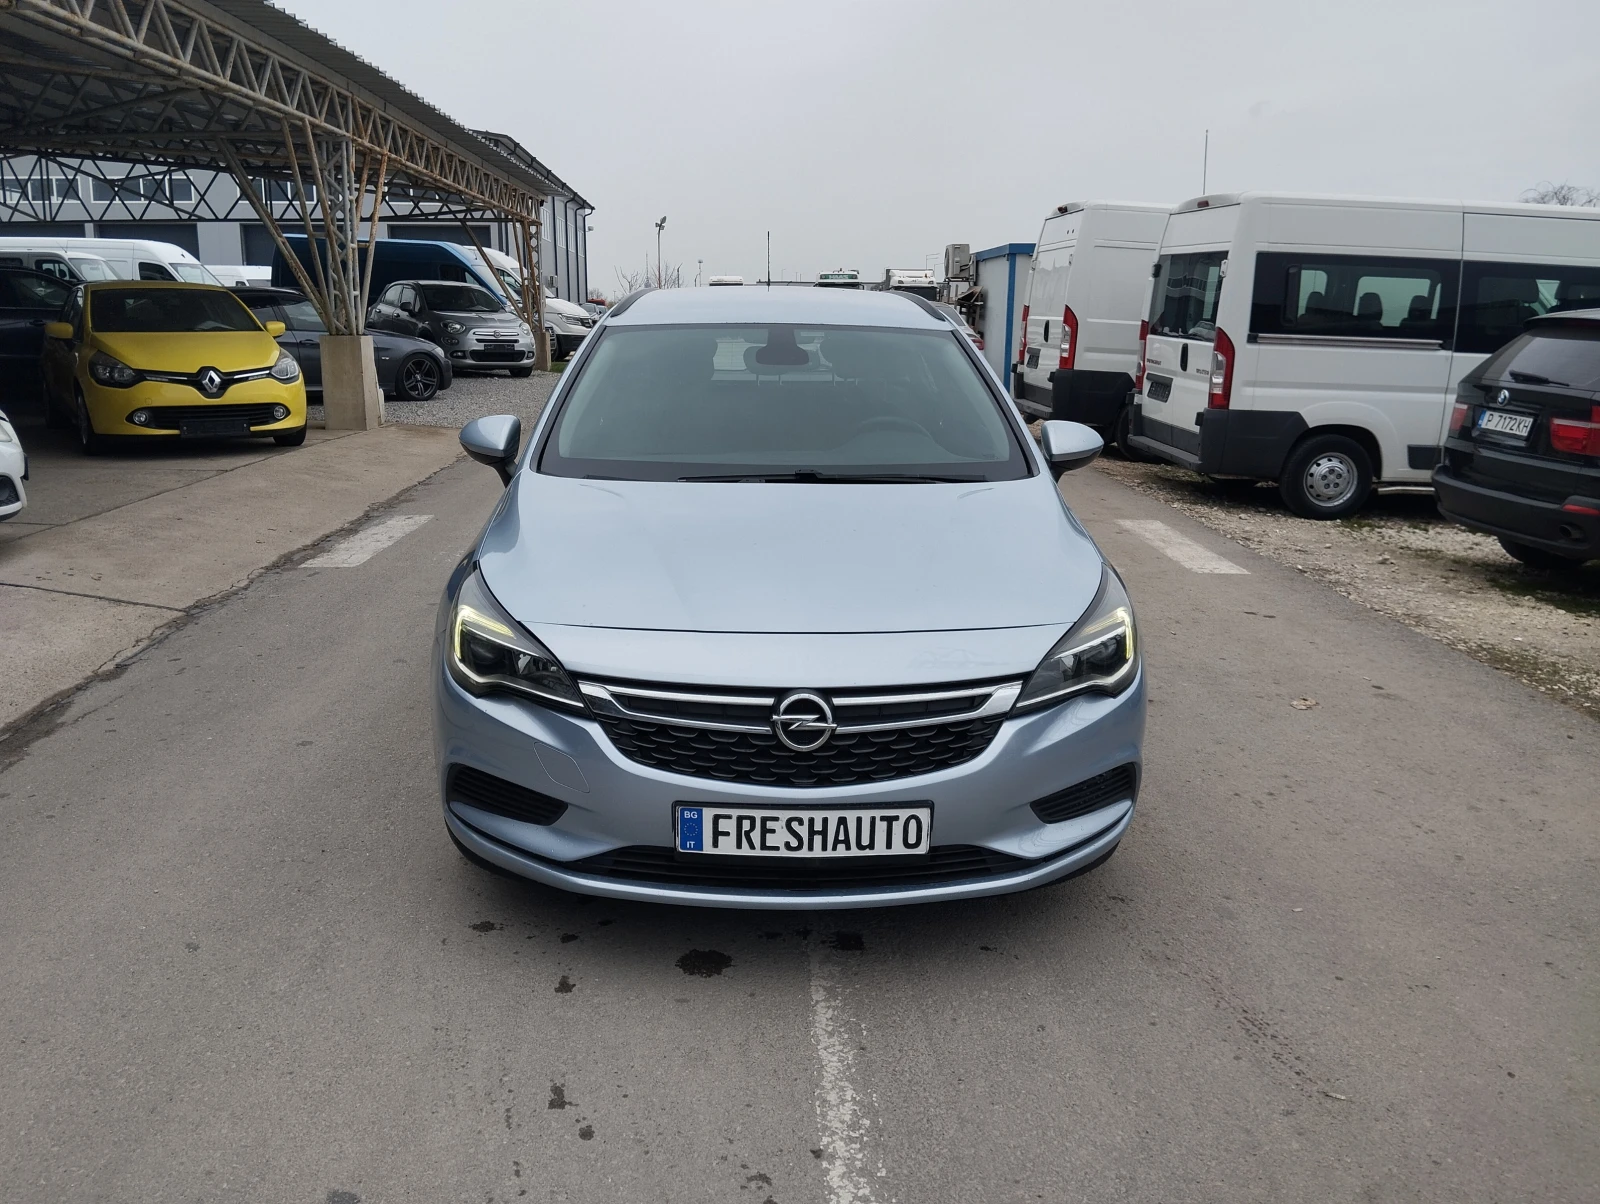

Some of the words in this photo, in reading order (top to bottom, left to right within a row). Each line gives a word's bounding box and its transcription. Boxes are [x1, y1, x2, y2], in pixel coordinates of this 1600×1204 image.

[1485, 413, 1494, 426] P
[684, 810, 698, 819] BG
[711, 813, 923, 852] FRESHAUTO
[686, 840, 696, 849] IT
